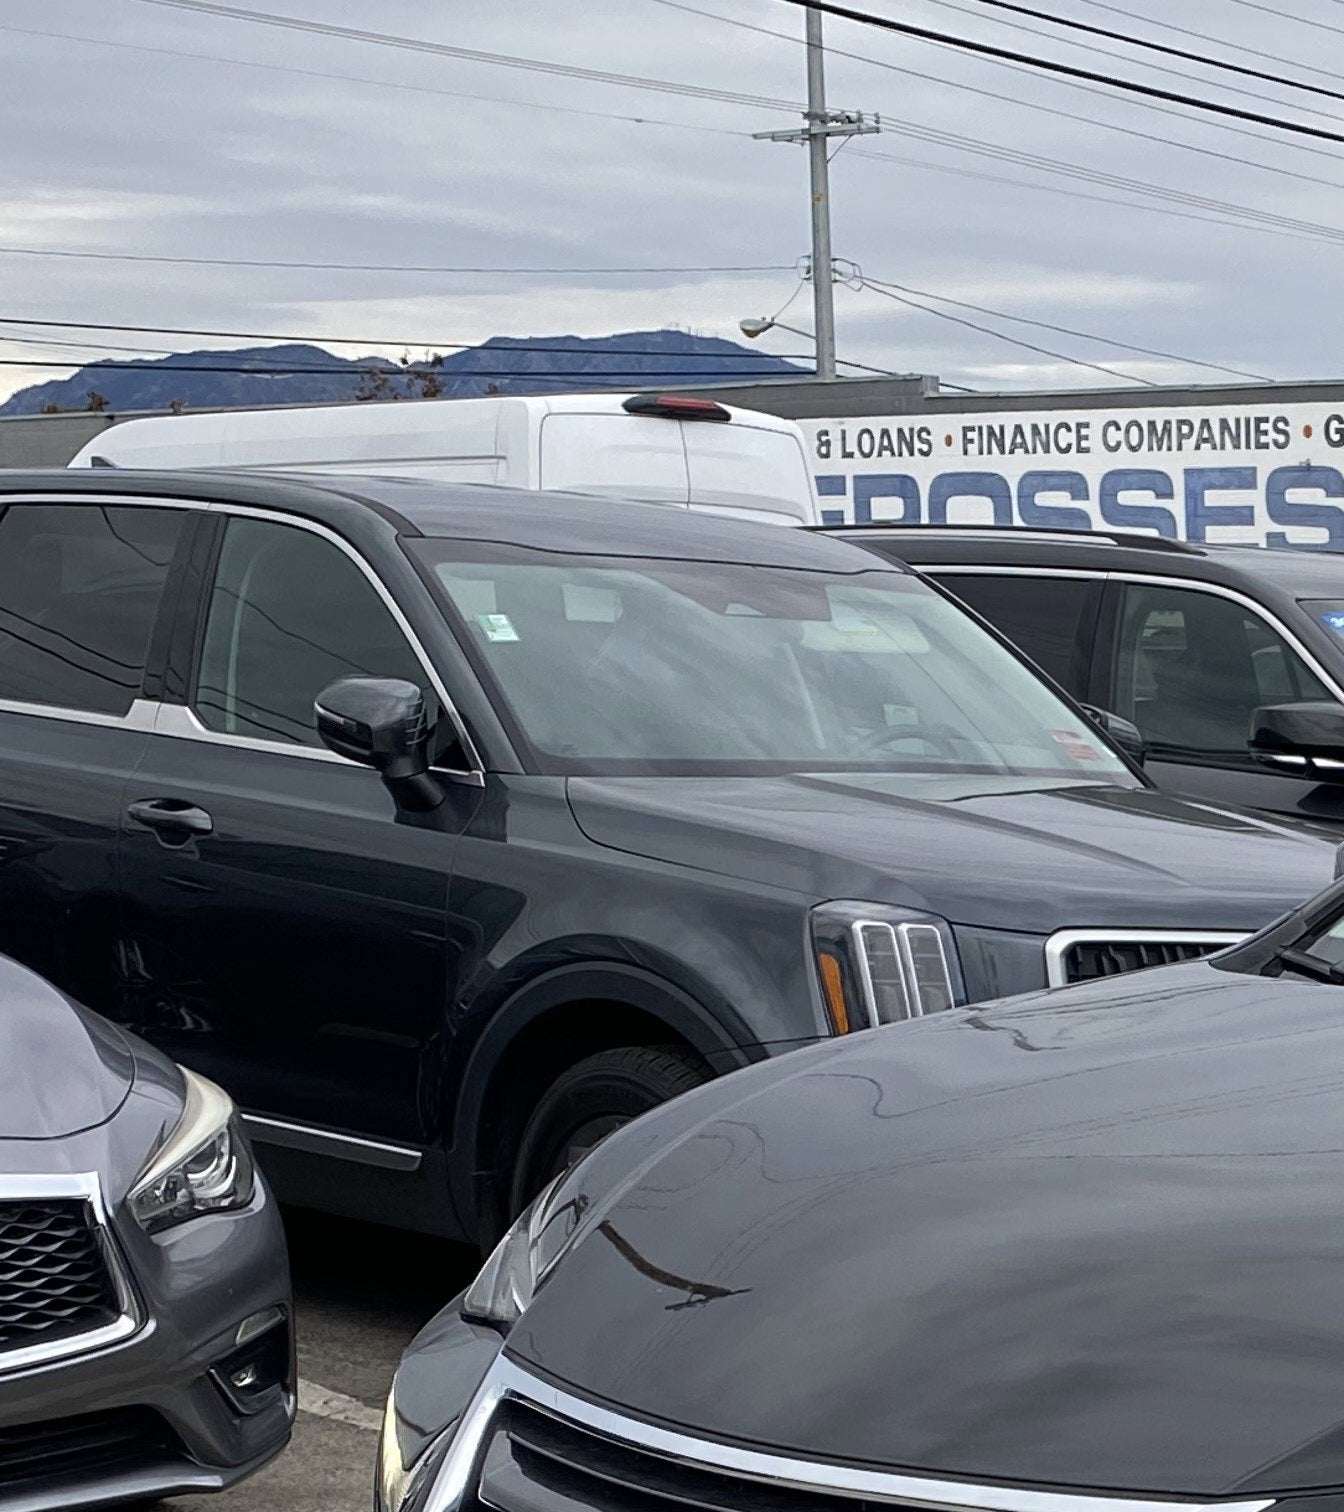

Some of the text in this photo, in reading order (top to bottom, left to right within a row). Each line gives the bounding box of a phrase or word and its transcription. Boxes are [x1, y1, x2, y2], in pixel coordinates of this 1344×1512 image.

[816, 432, 832, 458] &
[841, 427, 933, 458] LOANS
[961, 421, 1091, 456] FINANCE
[1102, 415, 1291, 453] COMPANIES
